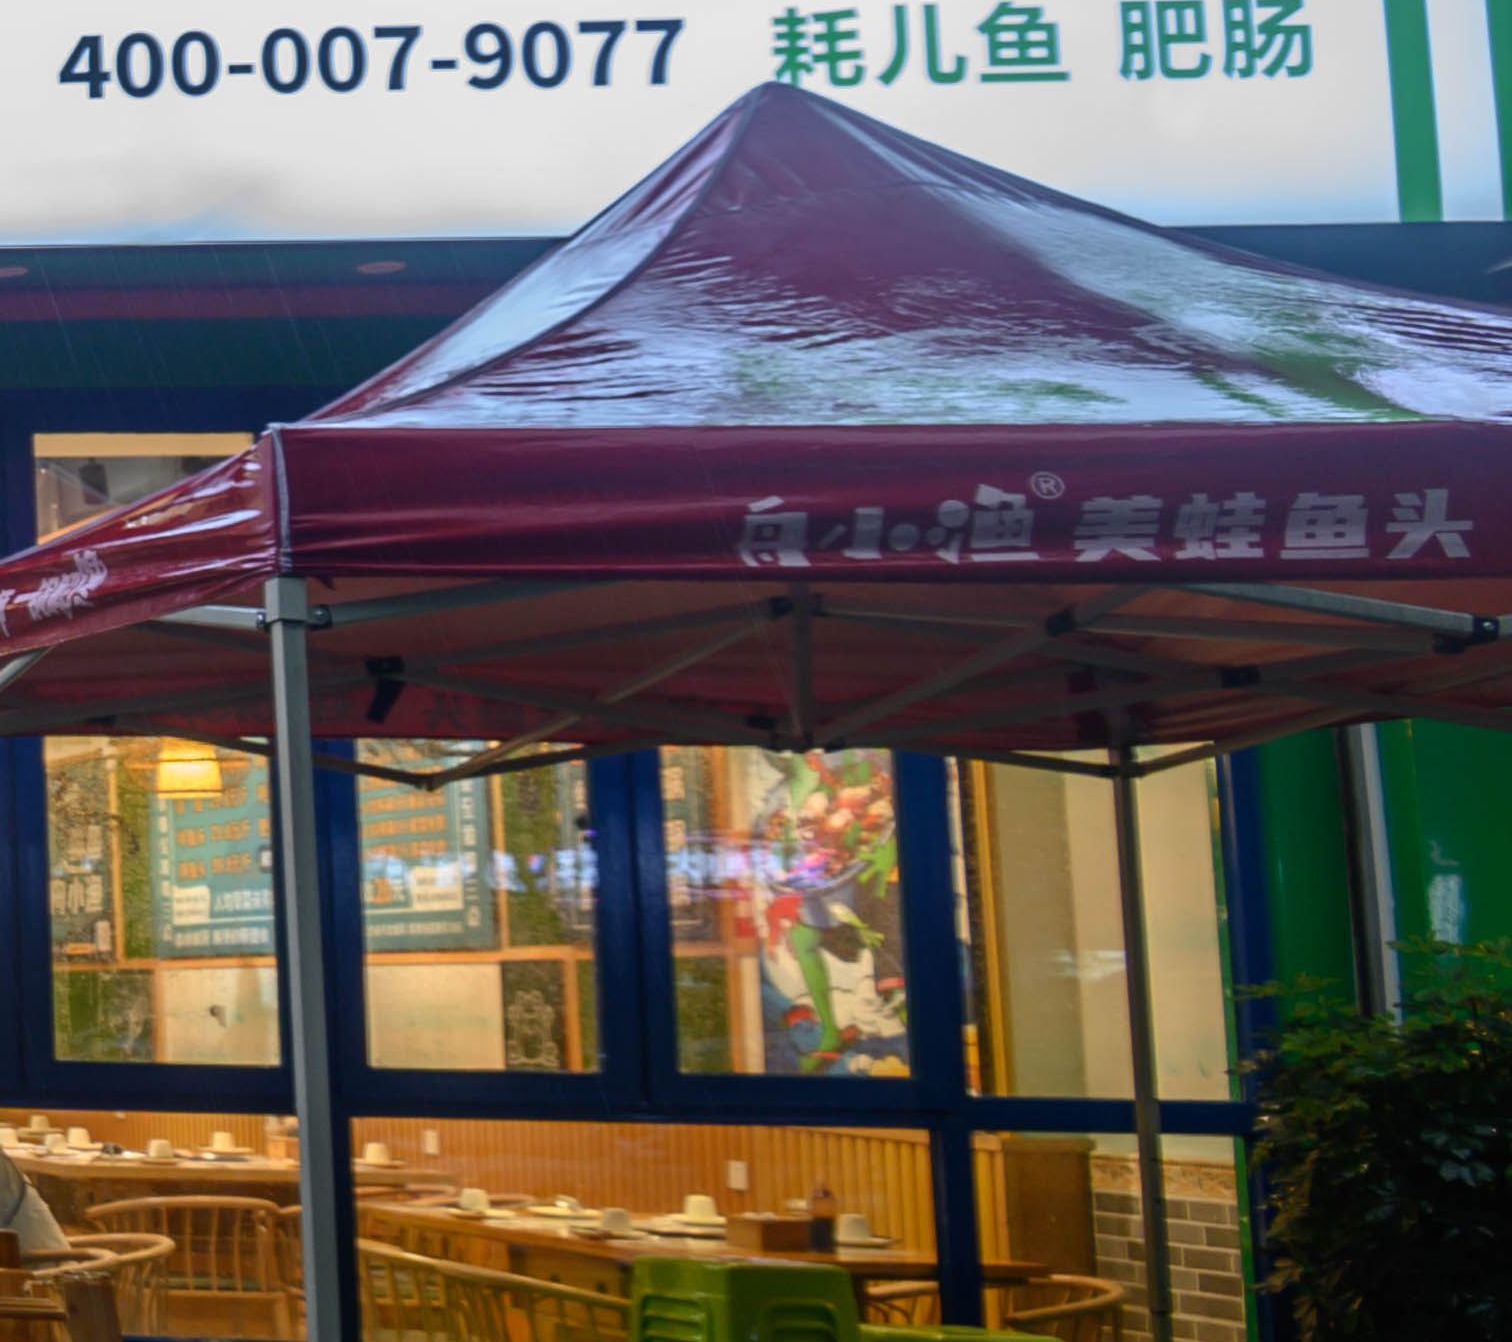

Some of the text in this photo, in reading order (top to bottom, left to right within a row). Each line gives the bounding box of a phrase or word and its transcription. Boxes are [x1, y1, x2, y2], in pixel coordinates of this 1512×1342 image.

[59, 19, 685, 99] 400-007-9077
[772, 2, 1071, 85] 耗儿鱼
[1074, 489, 1474, 563] 美蛙鱼头
